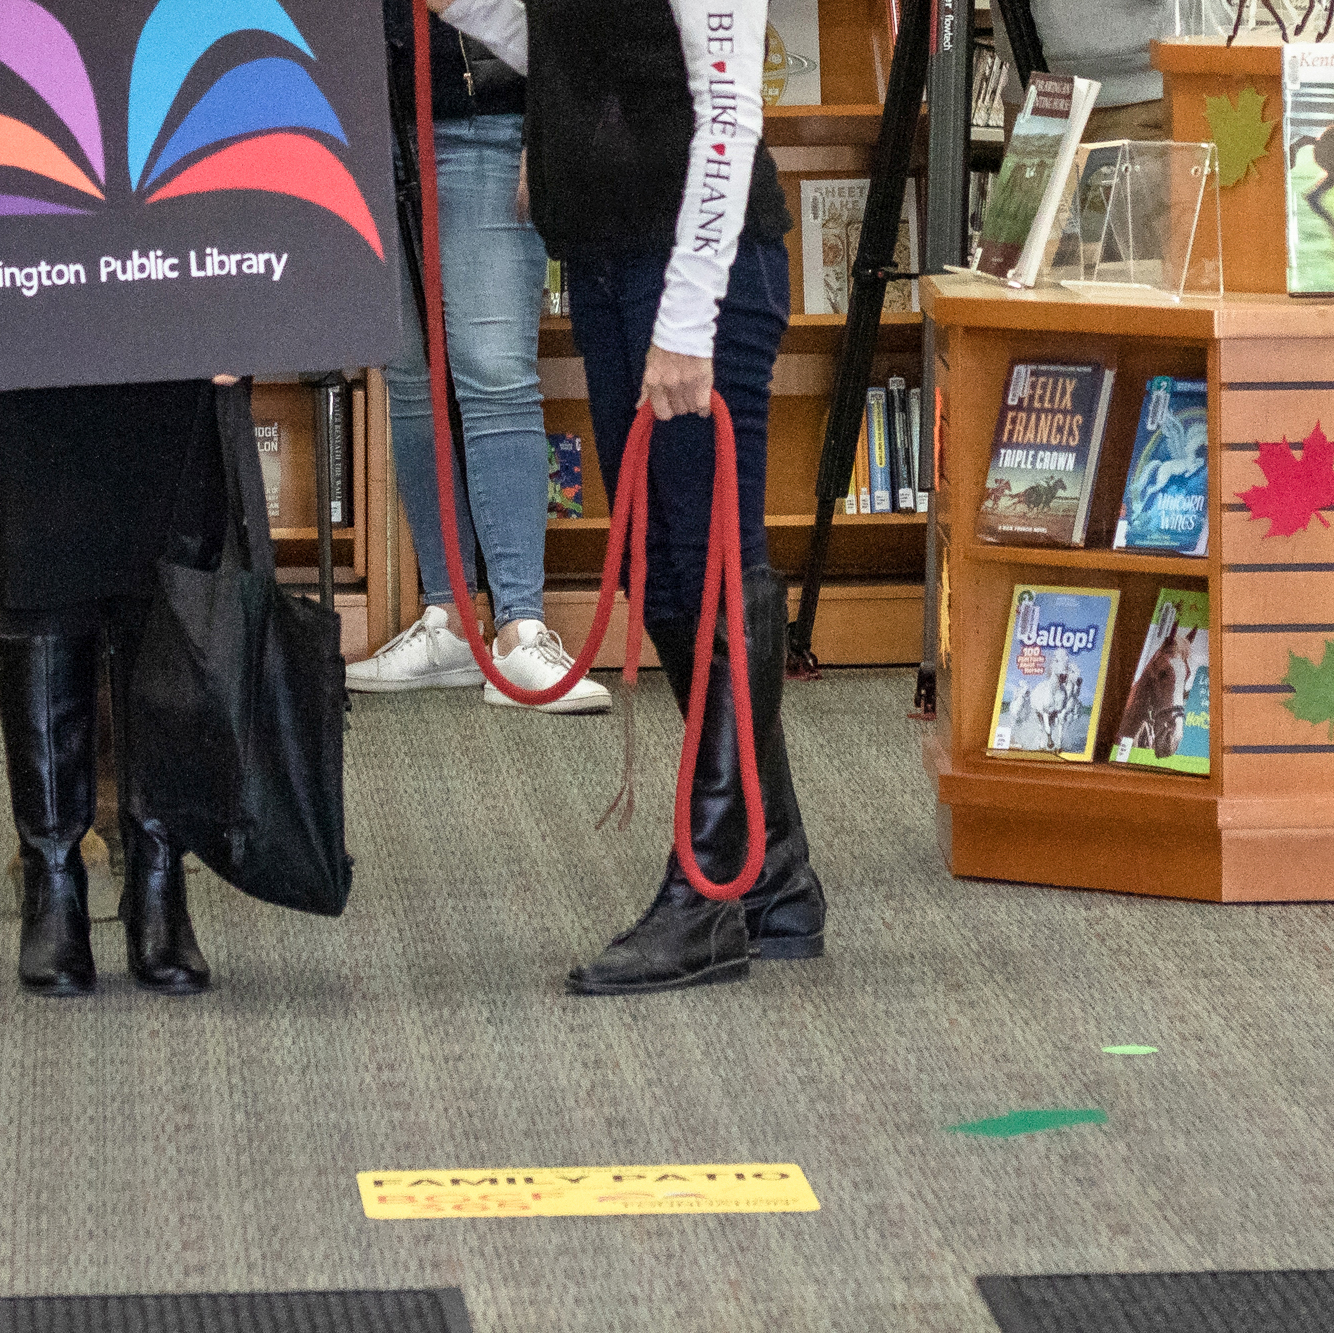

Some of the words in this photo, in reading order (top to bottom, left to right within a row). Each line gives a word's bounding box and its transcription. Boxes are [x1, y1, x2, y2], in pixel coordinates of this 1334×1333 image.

[706, 12, 734, 55] BE
[943, 14, 954, 51] flowtech
[709, 79, 738, 138] LIKE
[692, 157, 732, 254] HANK
[99, 250, 180, 282] Public
[189, 247, 289, 281] Library
[1023, 376, 1078, 410] FELIX
[334, 424, 342, 460] BENEATH
[1002, 411, 1083, 447] FRANCIS
[999, 448, 1035, 469] TRIPLE
[1036, 451, 1077, 472] CROWN
[1157, 493, 1206, 512] UNICORN
[1159, 513, 1197, 532] WINGS
[372, 1176, 588, 1188] FAMILY
[611, 1172, 791, 1182] PATIO
